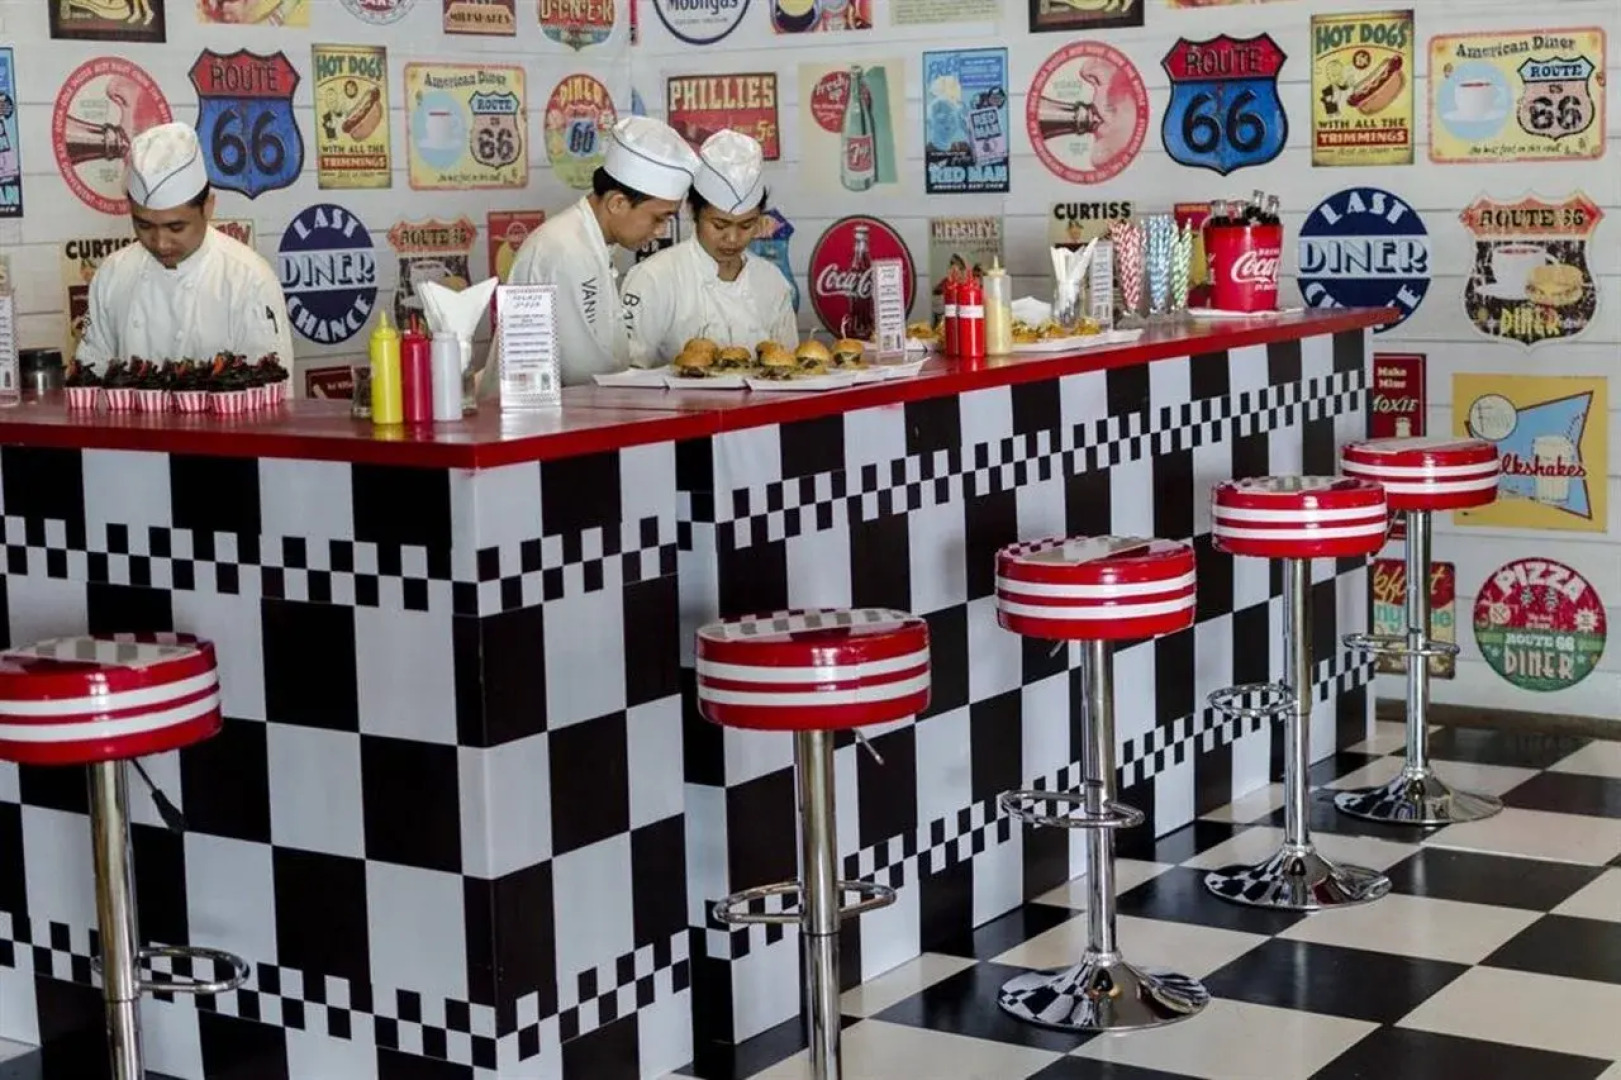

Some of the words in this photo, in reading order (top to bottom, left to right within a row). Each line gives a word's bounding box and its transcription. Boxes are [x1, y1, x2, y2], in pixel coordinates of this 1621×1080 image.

[1315, 24, 1355, 54] HOT
[1360, 21, 1409, 49] DOGS
[1456, 40, 1529, 59] American
[1532, 35, 1576, 51] Diner
[316, 55, 343, 82] HOT
[347, 54, 383, 82] DOGS
[1186, 48, 1261, 76] ROUTE
[1530, 64, 1583, 78] ROUTE
[210, 62, 279, 92] ROUTE
[424, 72, 476, 88] American
[559, 74, 604, 107] DINER
[477, 99, 513, 111] ROUTE
[669, 75, 774, 111] PHILLIES
[1182, 89, 1267, 154] 66
[1318, 120, 1350, 128] WITH
[1355, 119, 1377, 128] ALL
[1382, 118, 1407, 128] THE
[1529, 95, 1583, 130] 66
[212, 108, 285, 177] 66
[478, 127, 515, 160] 66
[570, 122, 596, 154] 66
[1320, 130, 1406, 144] TRIMMINGS
[323, 157, 386, 168] TRIMMINGS
[929, 163, 966, 184] RED
[967, 165, 1007, 182] MAN
[1054, 202, 1131, 220] CURTISS
[1320, 191, 1409, 225] LAST
[1479, 209, 1555, 227] ROUTE
[293, 207, 360, 241] LAST
[401, 229, 449, 247] ROUTE
[66, 238, 140, 260] CURTI
[1299, 240, 1428, 274] DINER
[280, 253, 376, 288] DINER
[287, 294, 372, 342] CHANCE
[1501, 305, 1561, 337] DINER
[1377, 366, 1407, 377] Make
[1378, 378, 1407, 389] Mine
[1500, 453, 1588, 477] lkshakes
[1493, 562, 1588, 603] PIZZA
[1505, 632, 1554, 647] ROUTE
[1504, 645, 1575, 681] DINER
